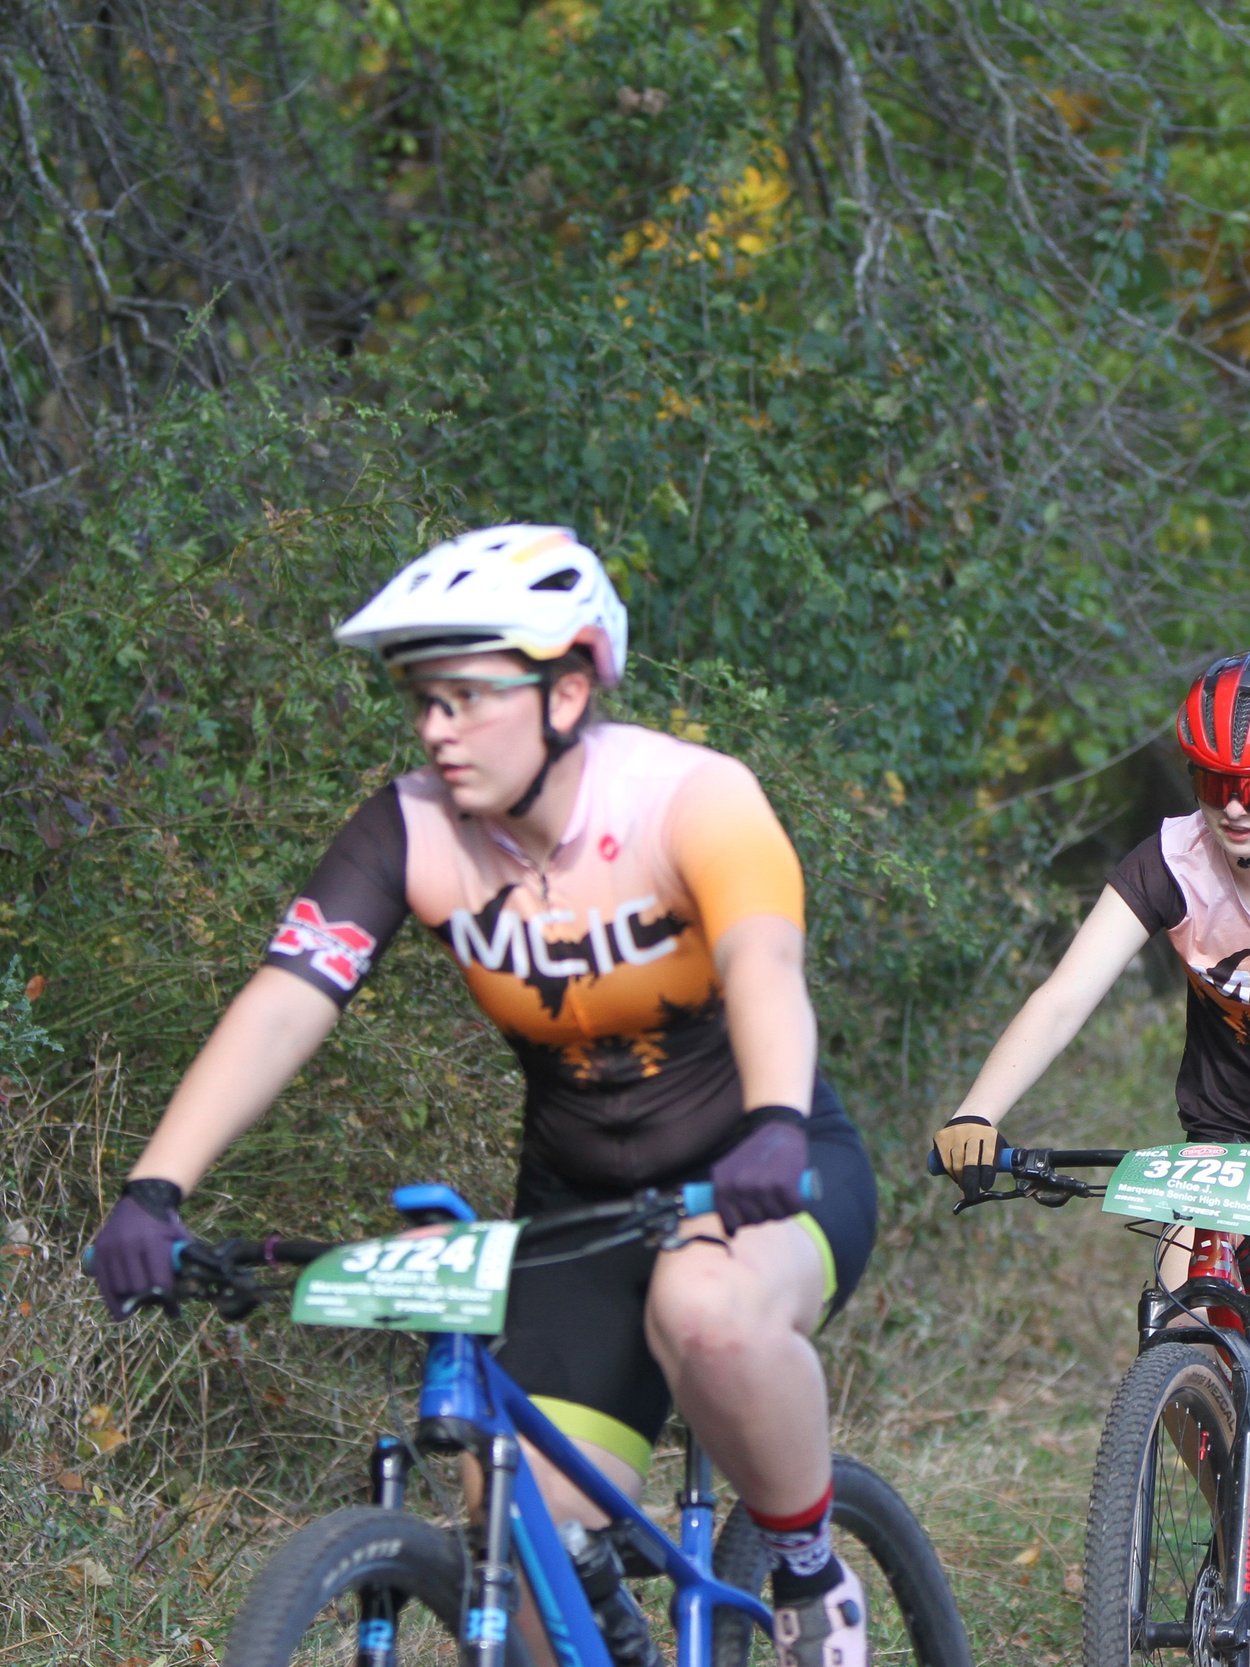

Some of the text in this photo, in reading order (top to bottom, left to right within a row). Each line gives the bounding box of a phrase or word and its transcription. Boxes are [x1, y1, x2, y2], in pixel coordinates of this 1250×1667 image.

[449, 896, 679, 979] MCIC
[1143, 1159, 1246, 1188] 3725
[1167, 1179, 1212, 1195] Chloe J.
[1118, 1183, 1164, 1198] Marquette
[1167, 1190, 1197, 1202] Senior
[1199, 1195, 1221, 1207] High
[342, 1235, 478, 1272] 3724
[1206, 1378, 1236, 1432] MEZCAL
